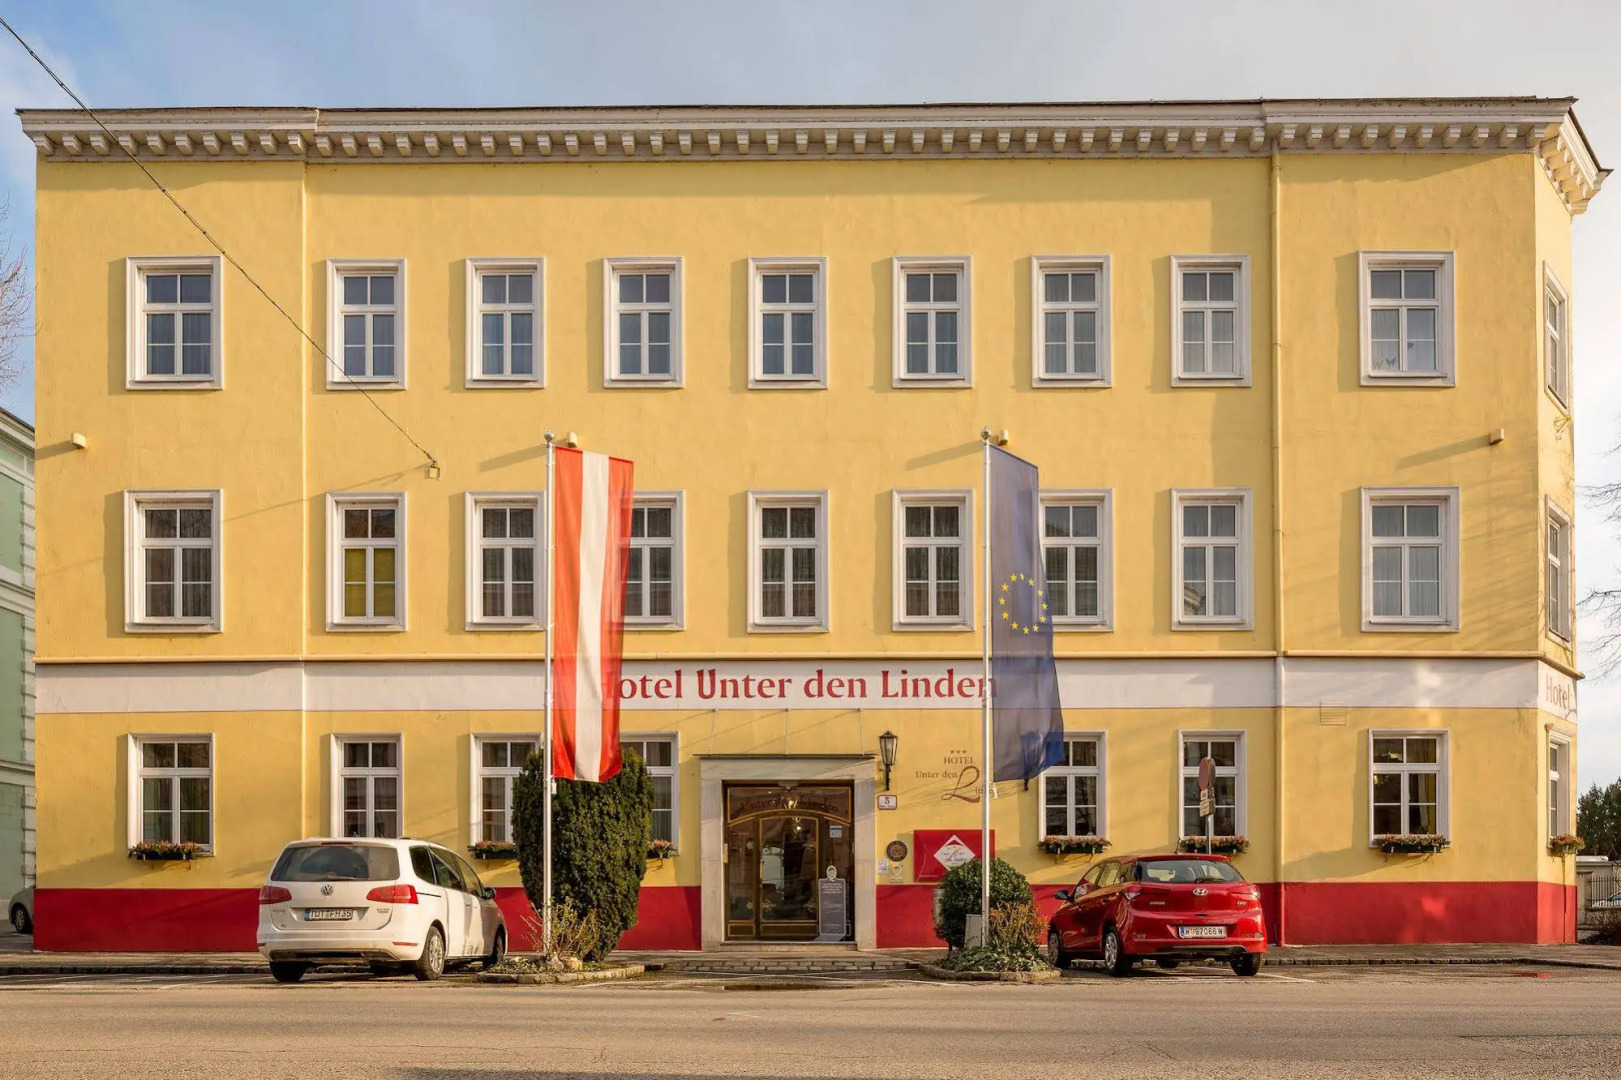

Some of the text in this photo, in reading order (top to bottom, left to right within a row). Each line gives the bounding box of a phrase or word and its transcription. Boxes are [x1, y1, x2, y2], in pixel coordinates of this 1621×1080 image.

[618, 668, 997, 700] otel Unter den Linden
[1546, 672, 1570, 710] Hotel
[943, 756, 974, 764] HOTEL
[915, 769, 958, 778] Unter den
[884, 796, 890, 804] 5
